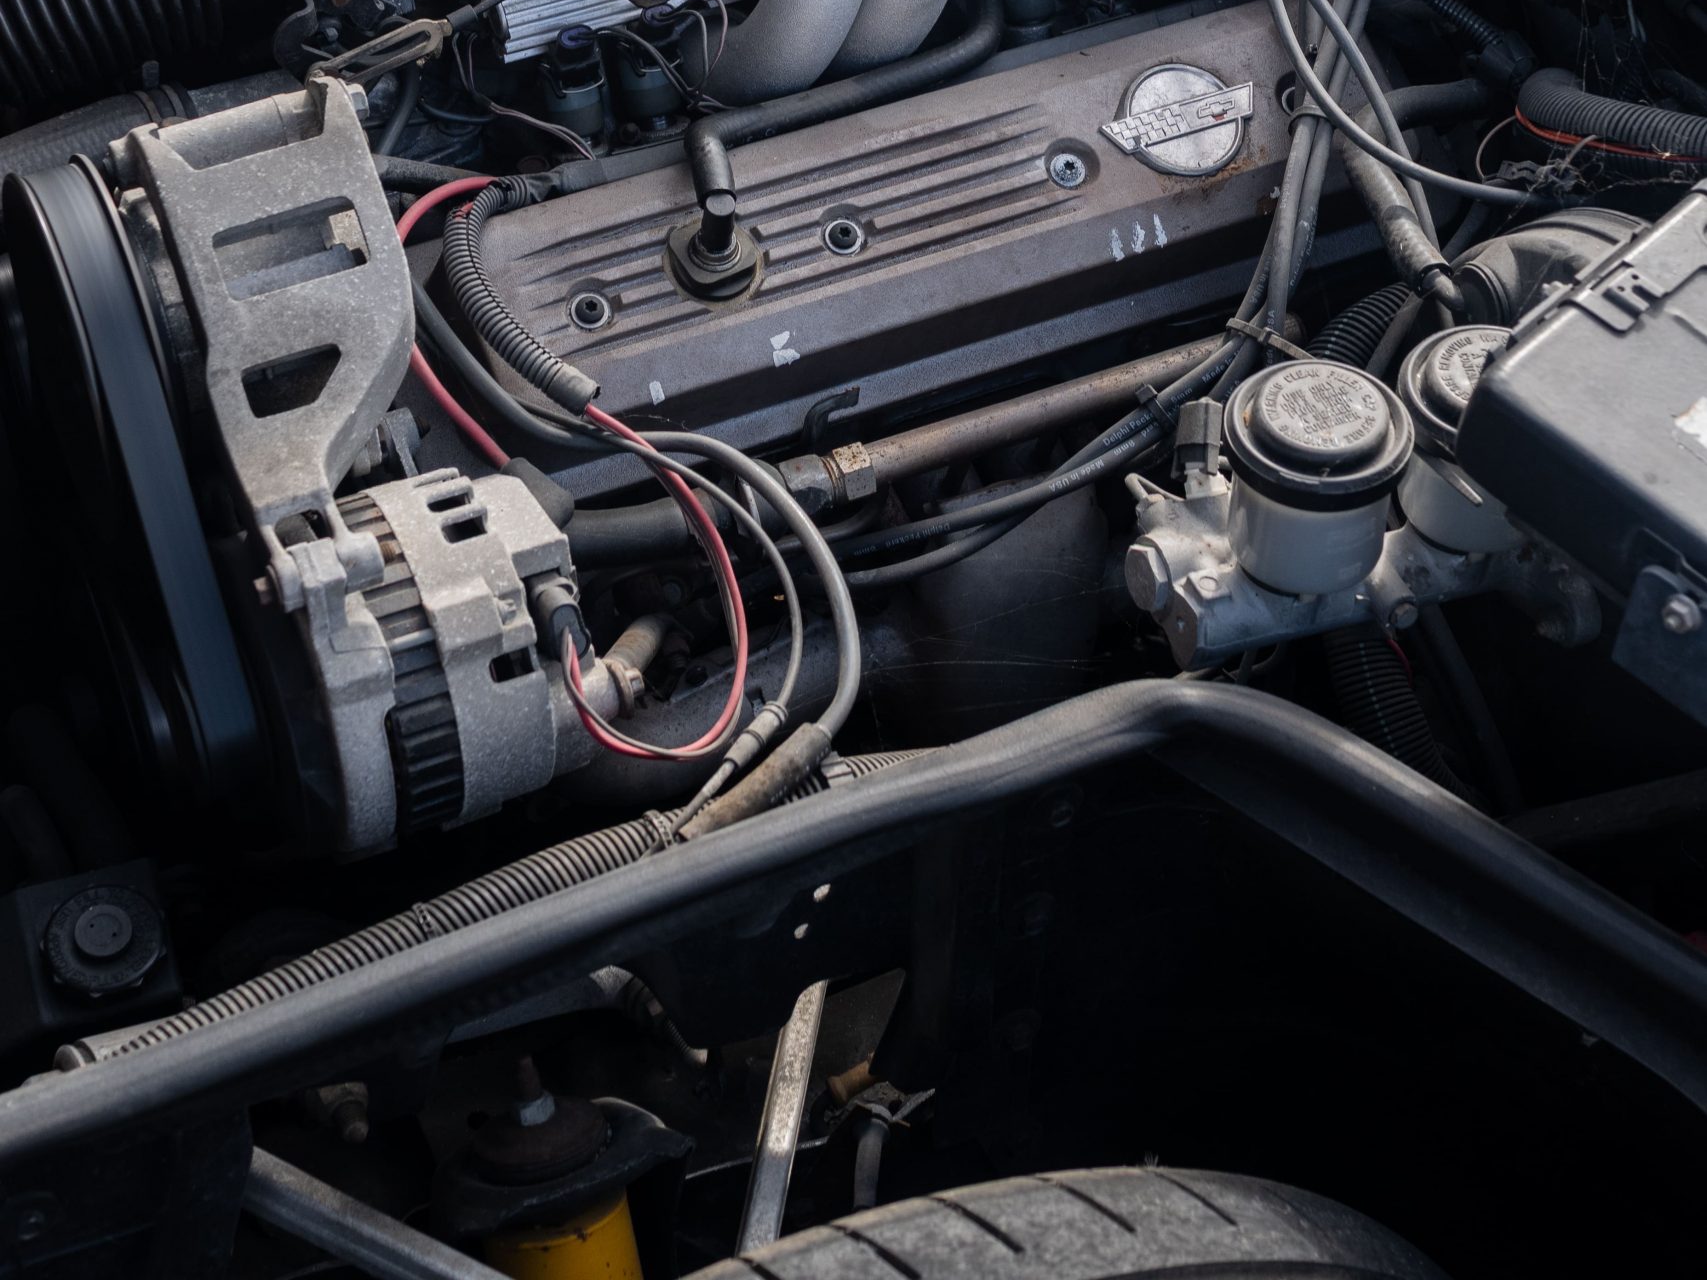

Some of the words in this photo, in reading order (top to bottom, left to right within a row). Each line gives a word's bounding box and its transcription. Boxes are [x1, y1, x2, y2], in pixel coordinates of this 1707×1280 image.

[1283, 368, 1320, 384] CLEAN
[1308, 381, 1335, 395] ONLY
[1303, 411, 1362, 434] CONTAINER
[1102, 424, 1130, 446] Delphi
[1080, 459, 1105, 476] Made
[1070, 471, 1079, 481] in
[1048, 477, 1070, 492] USA
